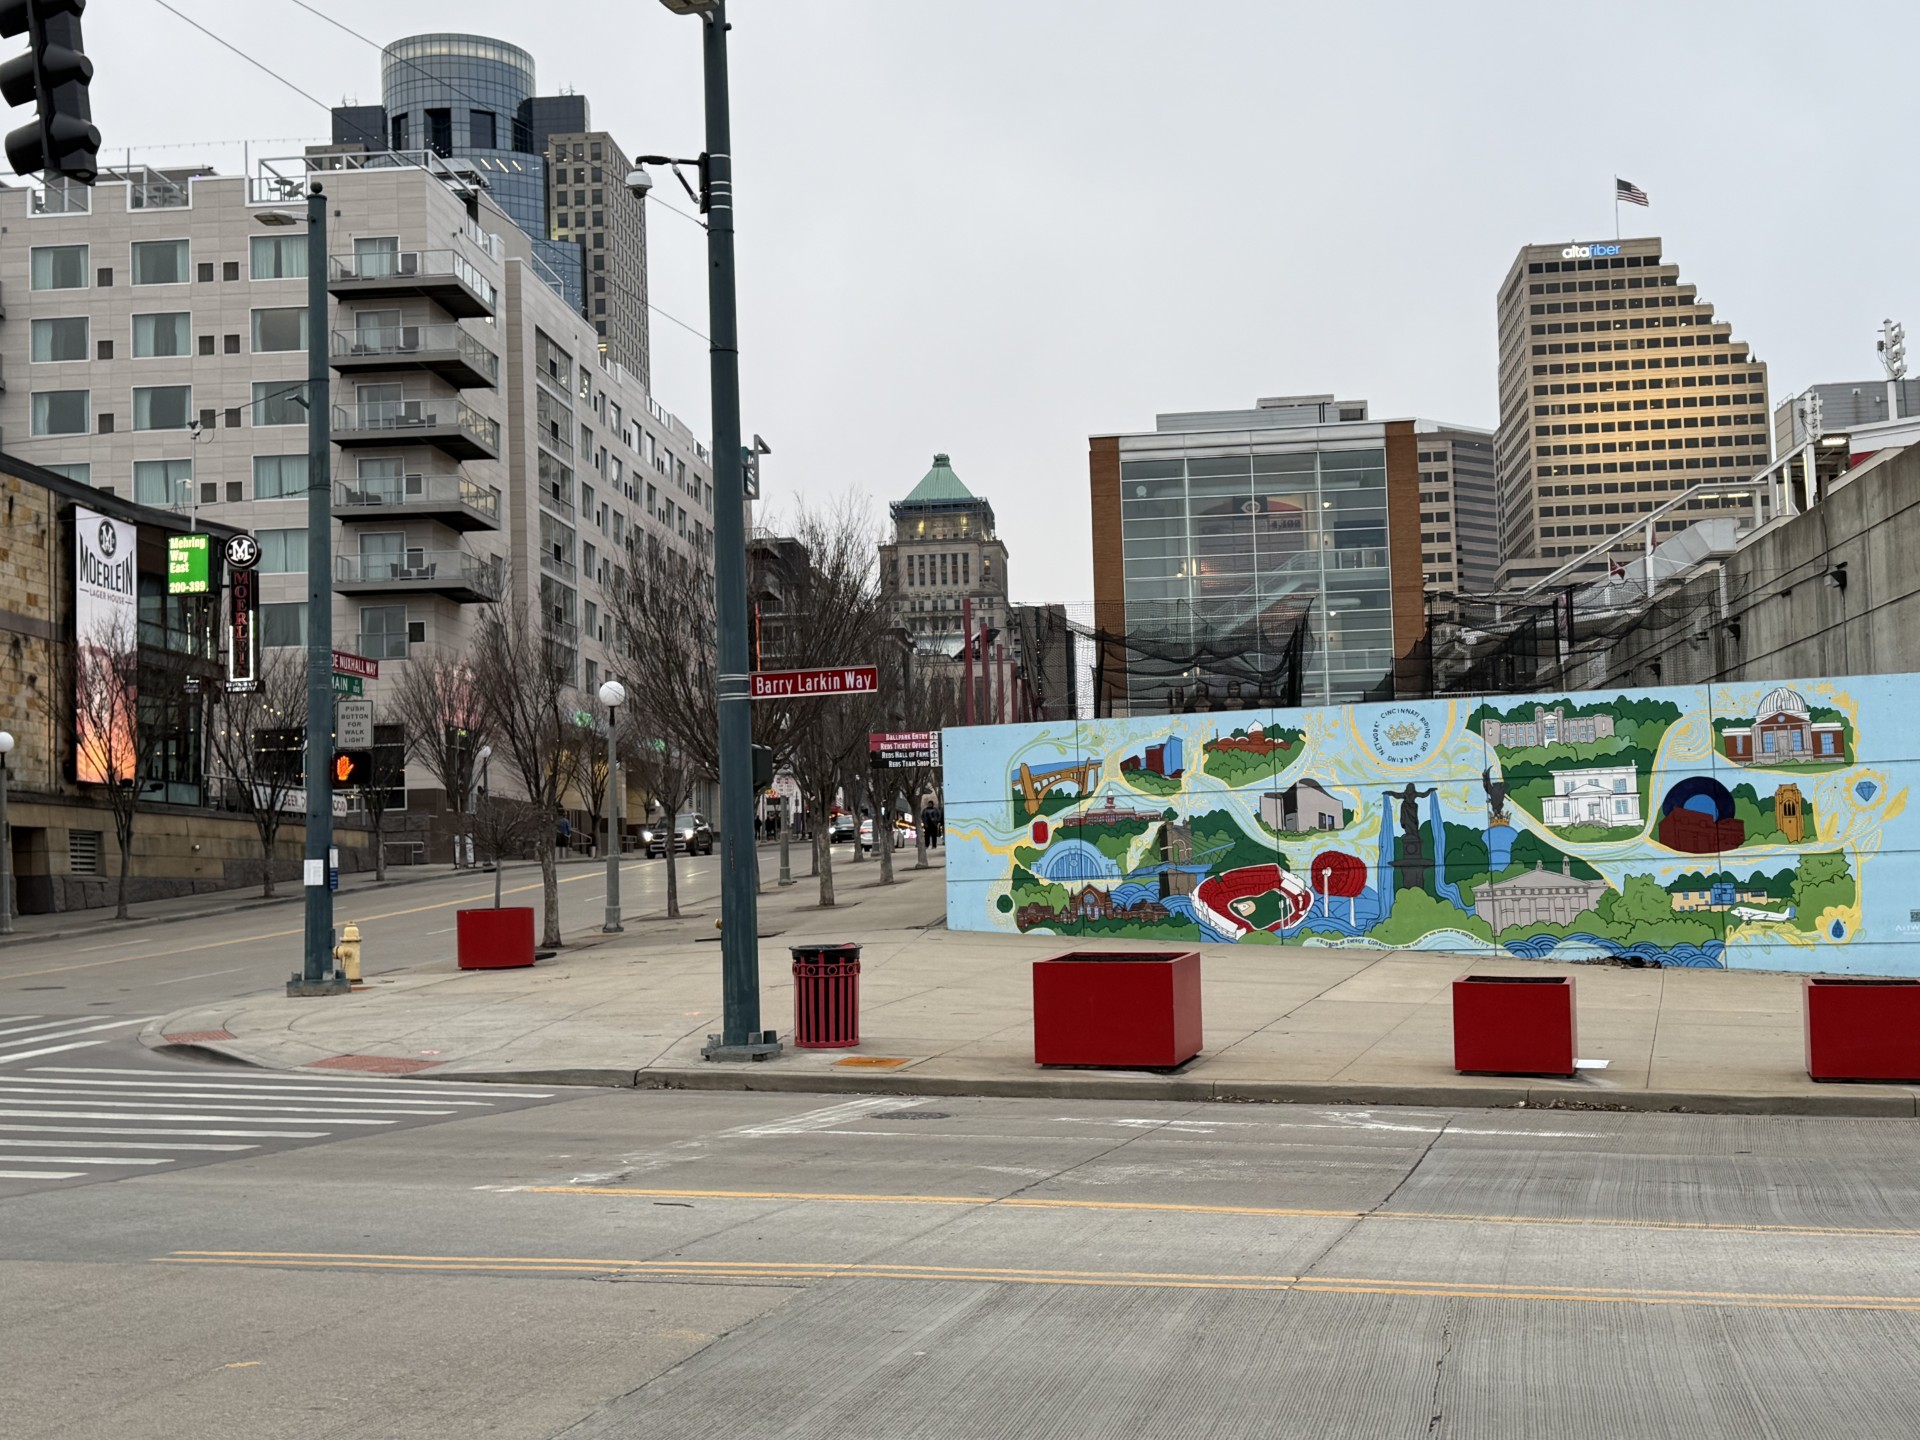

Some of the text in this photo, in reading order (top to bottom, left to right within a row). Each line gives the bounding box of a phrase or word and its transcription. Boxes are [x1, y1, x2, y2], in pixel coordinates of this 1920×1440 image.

[1562, 244, 1621, 259] altafiber
[169, 536, 206, 550] Mehring
[170, 550, 189, 562] Way
[79, 532, 133, 596] MOERLEIN
[170, 562, 189, 574] East
[89, 588, 125, 606] LAGER HOUSE
[340, 654, 366, 674] NUXHALL
[365, 661, 377, 676] WAY
[756, 671, 872, 695] Barry Larkin Way
[1380, 708, 1421, 719] CINCINNATI
[1420, 716, 1431, 739] RIDING
[1386, 753, 1421, 763] WALKING
